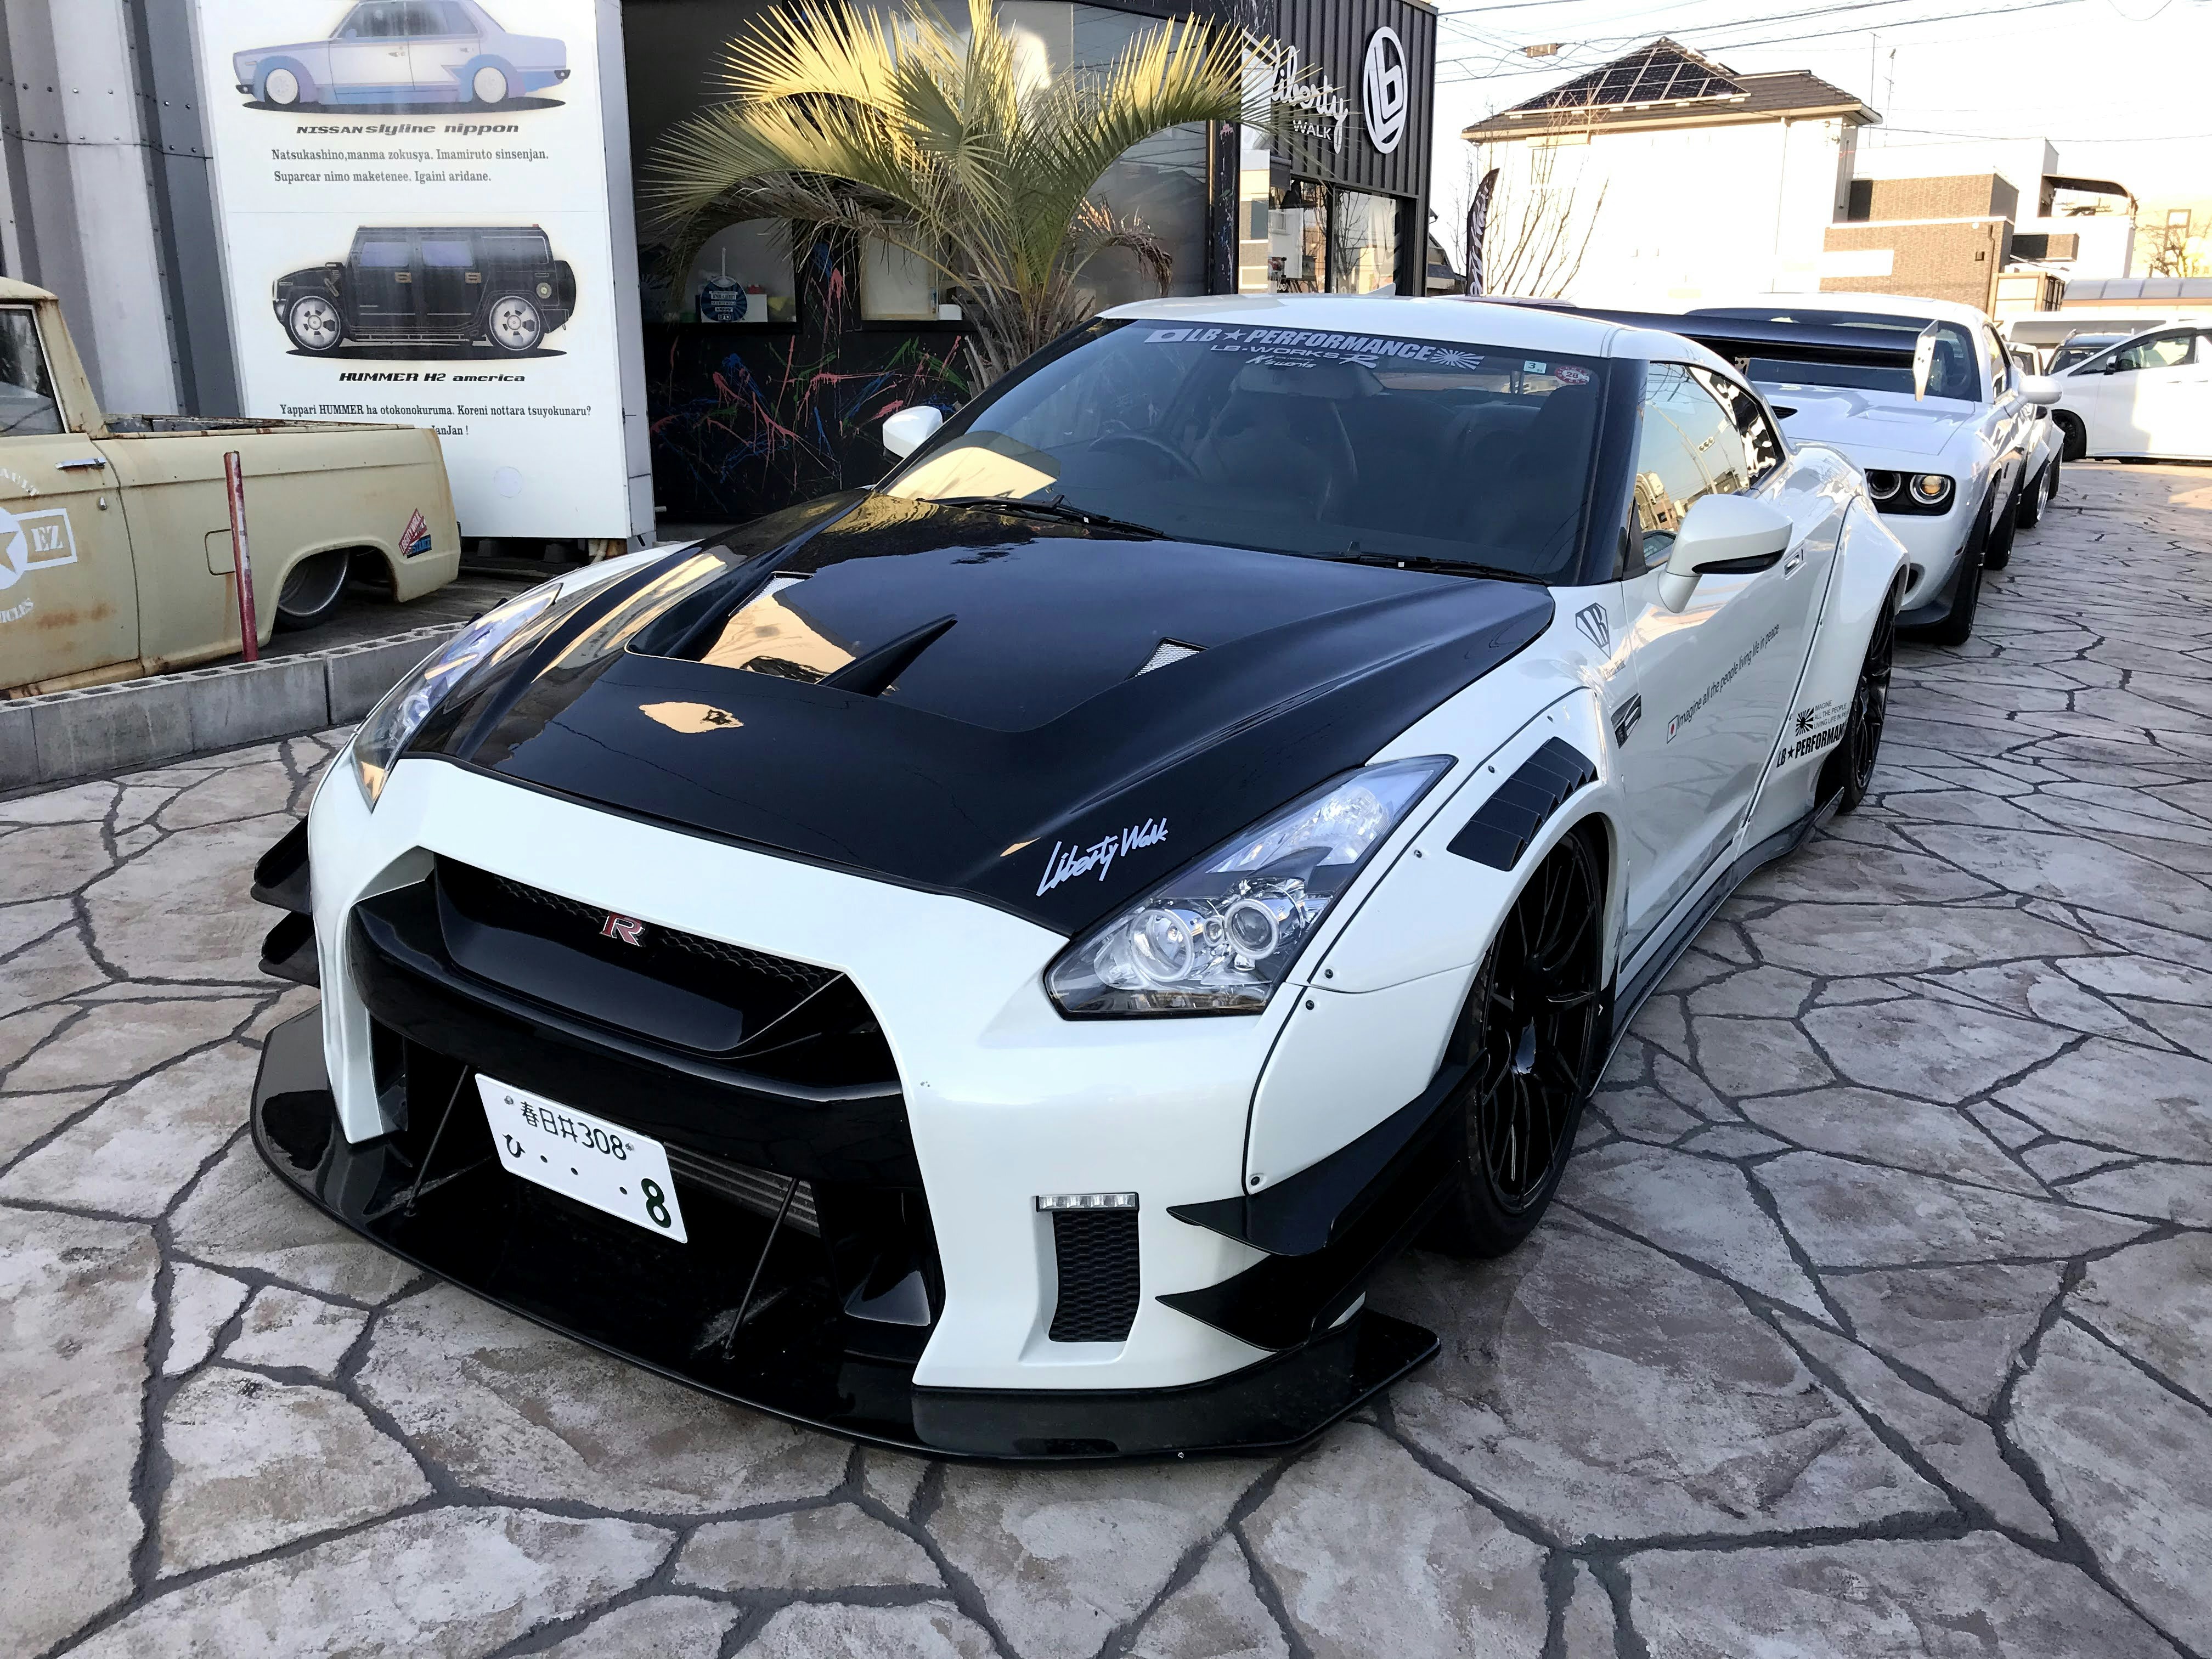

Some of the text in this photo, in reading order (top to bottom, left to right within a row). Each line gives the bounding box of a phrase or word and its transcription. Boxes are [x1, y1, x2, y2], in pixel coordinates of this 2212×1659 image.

[444, 123, 519, 136] nippon
[1293, 120, 1331, 140] WALK
[272, 148, 549, 162] Natsukashino,manma zokusya. Imamiruto sinsenjan.
[274, 171, 492, 184] Suparcar nimo maketenee. Igaini aridane.
[1186, 329, 1437, 362] LB PERFORMANCE
[339, 373, 526, 382] HUMMER H2 america
[280, 404, 591, 418] Yappari HUMMER ha otokonokuruma. Koreni nottara tsuyokunaru?
[1677, 698, 1702, 729] Imagine
[1702, 686, 1711, 706] all
[1711, 681, 1720, 698] the
[1720, 662, 1739, 693] people
[1739, 650, 1752, 671] living
[1760, 636, 1765, 650] in
[1765, 624, 1779, 649] peace
[1814, 699, 1833, 712] IMAGINE
[1822, 708, 1831, 718] THE
[1831, 703, 1847, 714] PEOPLE
[1814, 719, 1827, 729] LIVING
[1827, 715, 1836, 726] LIFE
[1776, 721, 1847, 768] LB PERFORMAN
[1036, 817, 1169, 897] Liberty Walk
[501, 1132, 526, 1159] ひ
